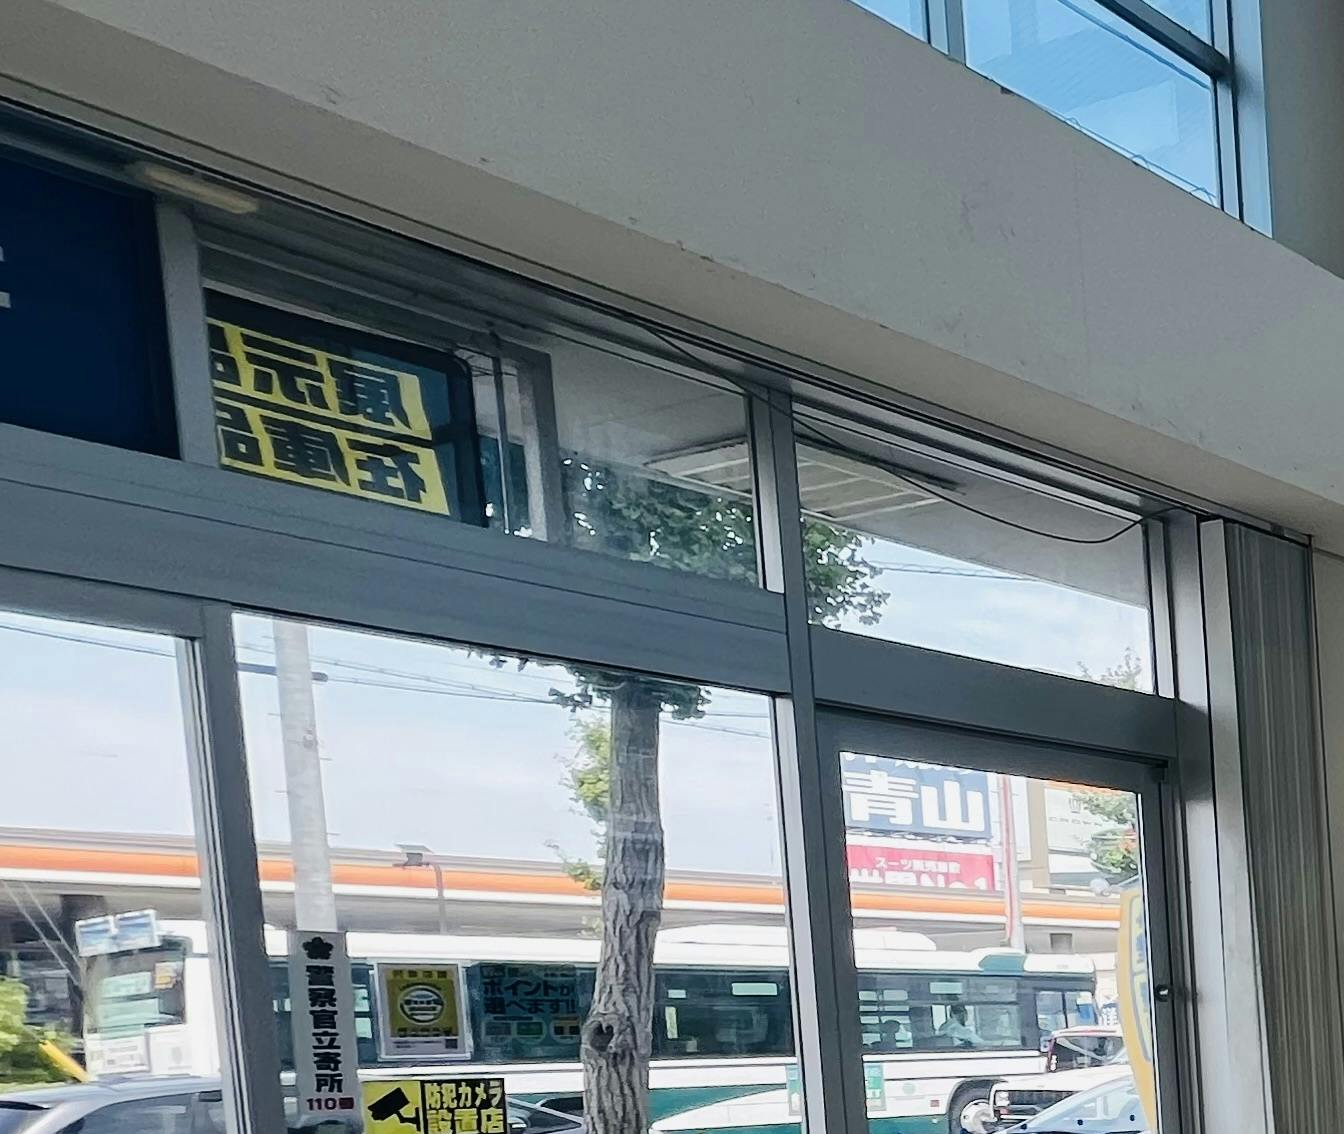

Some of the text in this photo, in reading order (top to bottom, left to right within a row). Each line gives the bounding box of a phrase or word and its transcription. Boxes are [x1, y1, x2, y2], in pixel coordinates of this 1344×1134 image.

[842, 769, 985, 832] 青山
[306, 965, 345, 1093] 警察官立寄所
[424, 1080, 504, 1109] 防犯カメラ
